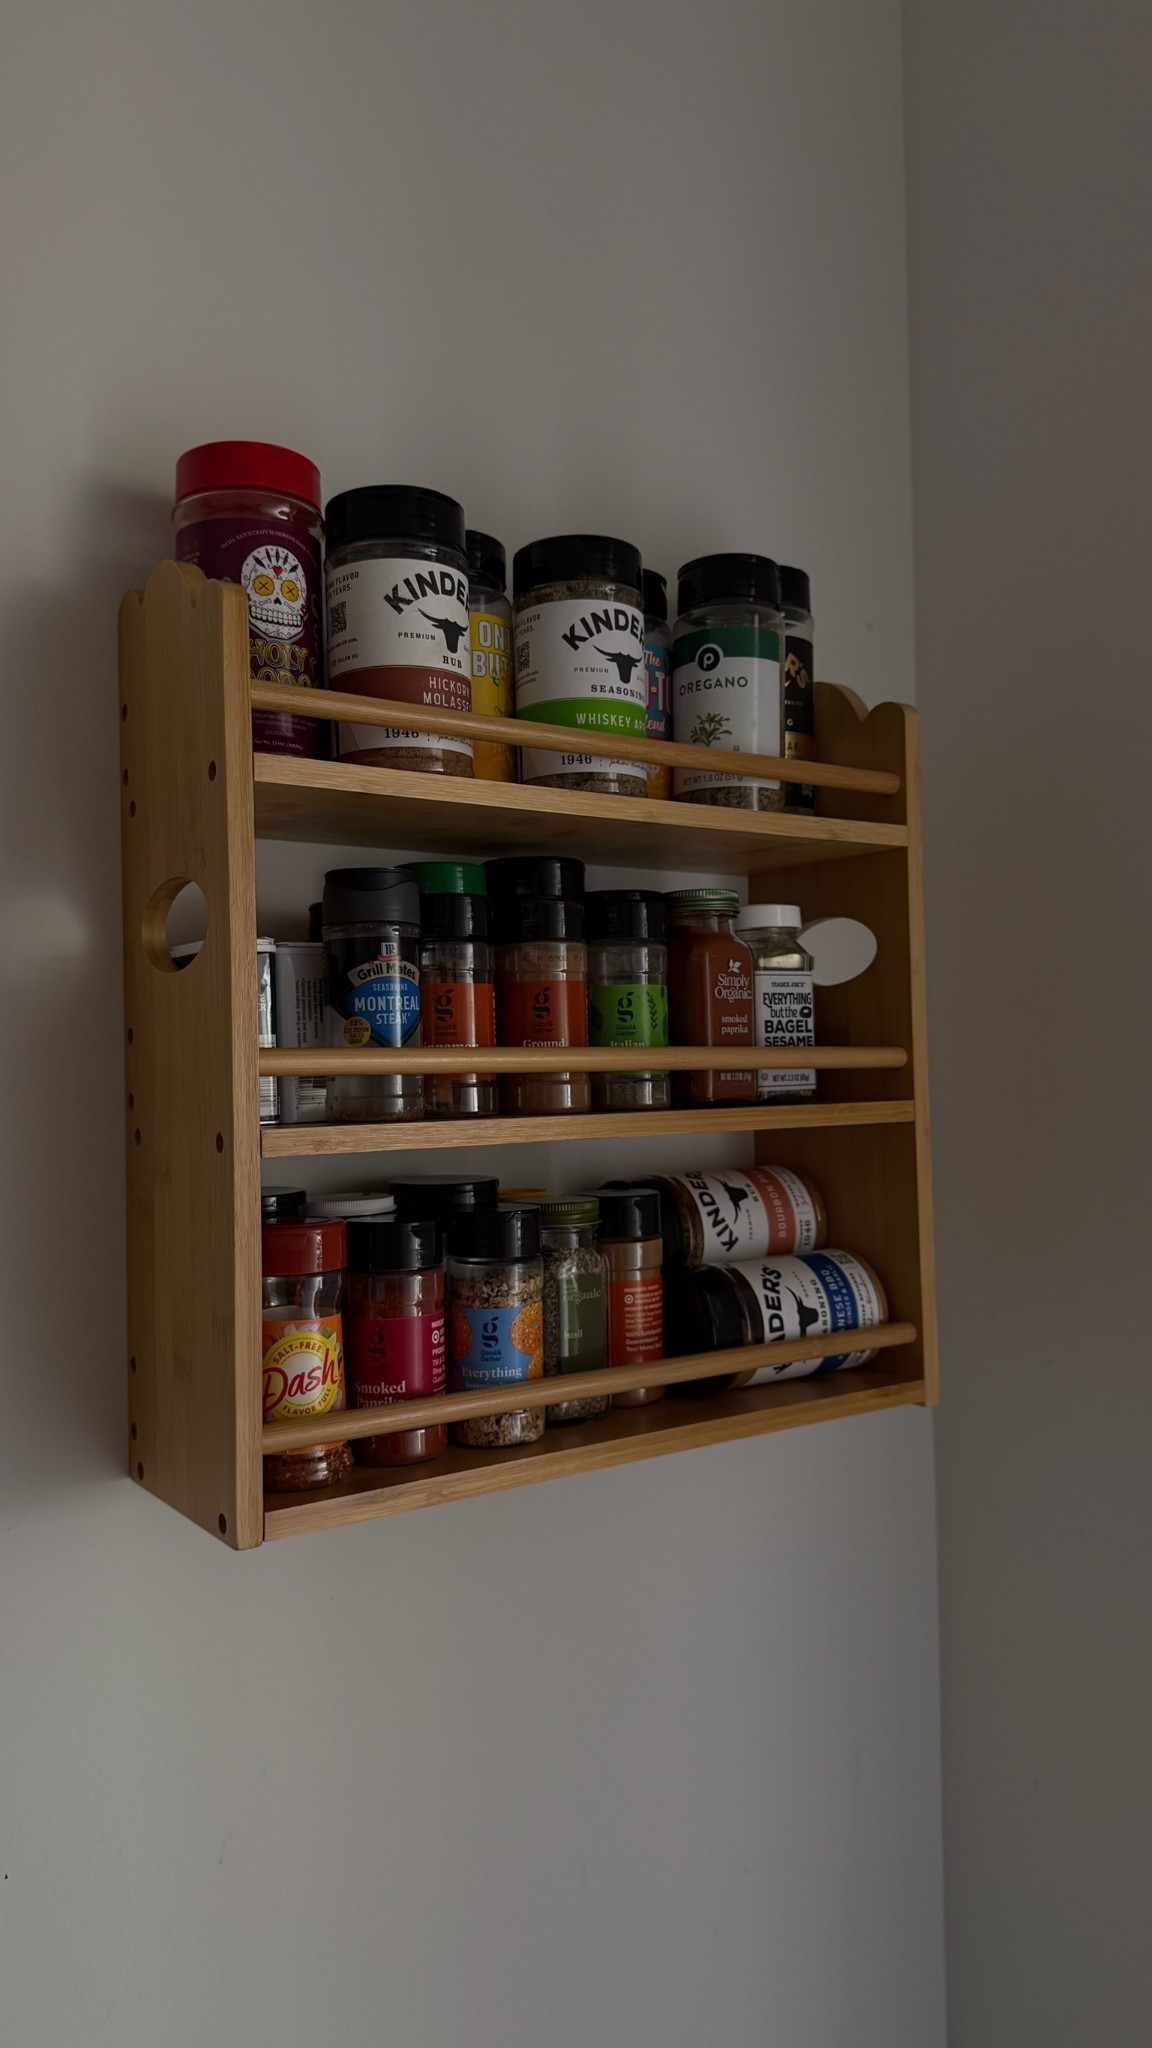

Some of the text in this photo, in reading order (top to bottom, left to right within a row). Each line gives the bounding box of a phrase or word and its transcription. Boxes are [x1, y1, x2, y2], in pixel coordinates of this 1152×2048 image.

[335, 571, 360, 588] FLAVOR
[384, 570, 470, 615] KINDE
[398, 632, 436, 641] PREMIUM
[562, 608, 644, 651] KINDE
[442, 655, 463, 669] RUB
[590, 684, 645, 701] SEASONIN
[679, 676, 749, 697] OREGANO
[423, 691, 472, 712] MOLASSE
[576, 713, 631, 728] WHISKEY
[384, 727, 420, 739] 1946
[561, 754, 592, 766] 1946
[357, 961, 416, 981] Grill Mates
[717, 972, 750, 990] Simply
[354, 995, 420, 1012] MONTREAL
[763, 992, 812, 1008] EVERYTHING
[376, 1013, 408, 1025] STEAK
[721, 1014, 748, 1024] smoked
[764, 1020, 813, 1034] BAGEL
[721, 1024, 749, 1036] paprika
[523, 1038, 569, 1048] Ground
[764, 1036, 813, 1047] SESAME
[765, 1184, 788, 1238] BOURBON
[820, 1268, 839, 1291] BBQ
[563, 1328, 584, 1339] basil
[273, 1341, 323, 1364] SALT-FREE
[262, 1347, 339, 1412] Dash
[462, 1365, 522, 1382] Everything
[355, 1380, 406, 1394] Smoked
[283, 1388, 332, 1415] FLAVOR FULL
